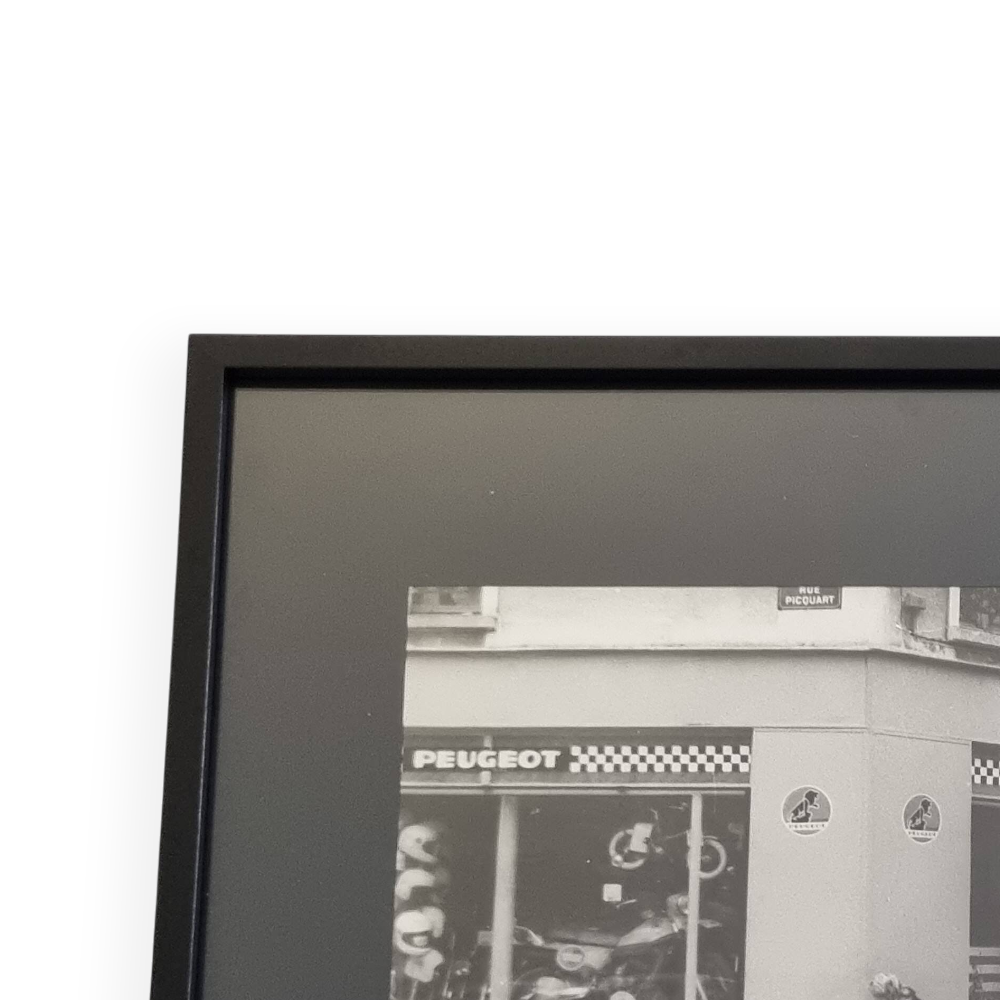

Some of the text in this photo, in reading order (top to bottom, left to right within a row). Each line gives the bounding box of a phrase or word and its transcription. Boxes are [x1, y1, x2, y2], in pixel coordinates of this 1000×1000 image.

[799, 586, 820, 594] RUE
[785, 595, 835, 606] PICQUART
[413, 749, 561, 769] PEUGEOT
